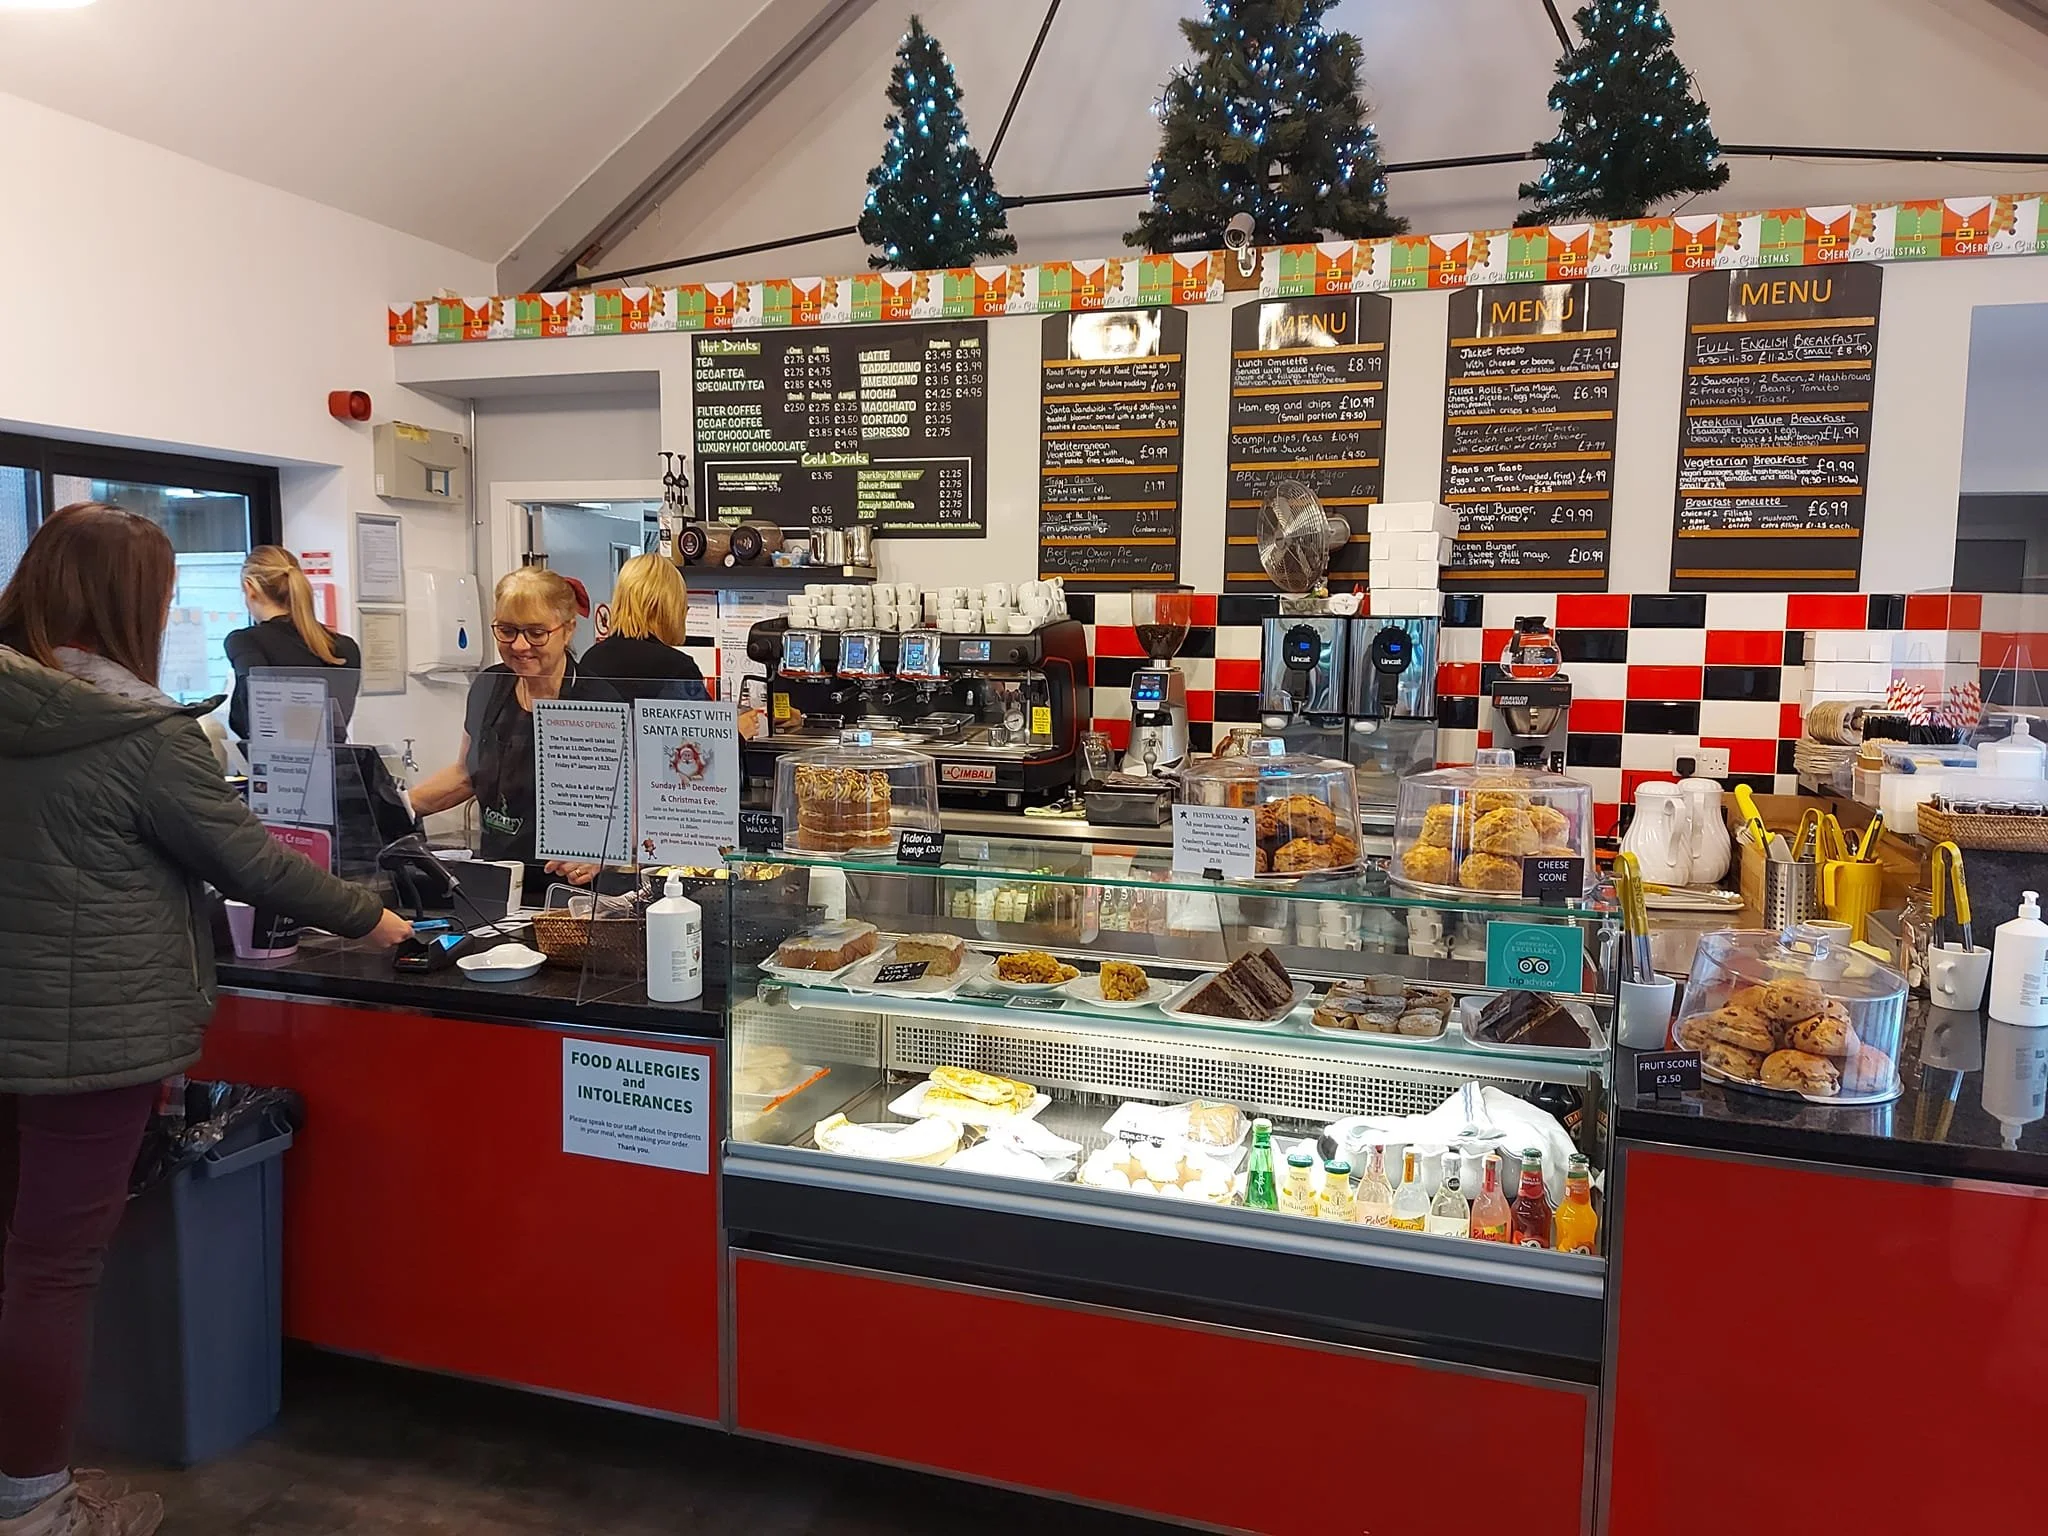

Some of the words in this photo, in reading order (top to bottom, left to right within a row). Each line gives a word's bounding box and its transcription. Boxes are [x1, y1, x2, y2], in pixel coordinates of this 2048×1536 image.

[1741, 279, 1832, 305] MENU
[1492, 298, 1573, 324] MENU
[1273, 312, 1346, 336] MENU
[700, 340, 720, 352] Hot
[722, 339, 758, 352] Drinks
[1697, 337, 1734, 354] FULL
[1740, 337, 1789, 351] ENGLISH
[1794, 333, 1866, 348] BREAKFAST
[860, 351, 890, 361] LATTE
[925, 350, 952, 360] £3.45
[1571, 347, 1612, 366] £7.99
[696, 358, 712, 367] TEA
[860, 362, 920, 374] CAPPUCCINO
[925, 363, 952, 372] £3.45
[1238, 359, 1262, 367] Lunch
[1348, 357, 1381, 372] £8.99
[696, 369, 726, 380] DECAF
[726, 368, 744, 378] TEA
[696, 380, 746, 392] SPECIALITY
[746, 380, 764, 390] TEA
[861, 376, 918, 387] AMERICANO
[1690, 377, 1698, 385] 2
[861, 389, 896, 400] MOCHA
[925, 388, 952, 398] £4.25
[1449, 387, 1473, 395] Filled
[1510, 384, 1530, 392] Tuna
[1573, 386, 1608, 400] £6.99
[1760, 385, 1795, 394] Beans,
[1801, 384, 1839, 392] Tomato
[698, 406, 726, 416] FILTER
[728, 405, 762, 415] COFFEE
[862, 401, 916, 412] MACCHIATO
[925, 402, 951, 411] £2.85
[1238, 403, 1262, 412] Ham,
[1265, 403, 1279, 414] egg
[1284, 401, 1301, 410] and
[1308, 400, 1331, 410] chips
[1339, 396, 1374, 410] £10.99
[698, 418, 726, 428] DECAF
[728, 417, 762, 427] COFFEE
[862, 414, 908, 424] CORTADO
[925, 414, 952, 424] £3.25
[1307, 412, 1337, 421] portion
[1689, 417, 1742, 429] Weekday
[1750, 416, 1783, 426] Value
[1790, 414, 1846, 425] Breakfast
[698, 430, 716, 440] HOT
[718, 428, 771, 440] CHOCOLATE
[862, 427, 910, 438] ESPRESSO
[925, 427, 950, 437] £2.75
[1822, 426, 1859, 443] £4.99
[698, 442, 732, 452] LUXURY
[732, 442, 750, 452] HOT
[752, 440, 806, 451] CHOCOLATE
[1048, 441, 1110, 450] Mediterranean
[1140, 445, 1167, 459] £9.99
[802, 453, 827, 465] Cold
[830, 453, 868, 464] Drinks
[1684, 457, 1748, 469] Vegetarian
[1753, 456, 1808, 466] Breakfast
[1817, 458, 1855, 474] £9.99
[1451, 465, 1479, 474] Beans
[1498, 463, 1522, 472] Toast
[1578, 469, 1606, 483] £4.99
[1451, 476, 1469, 486] Eggs
[1488, 473, 1514, 482] Toast
[1496, 483, 1520, 492] Toast
[1494, 503, 1536, 518] Burger,
[1551, 507, 1593, 523] £9.99
[1685, 498, 1731, 508] Breakfast
[1736, 498, 1781, 506] omelette
[1808, 500, 1848, 517] £6.99
[1486, 542, 1517, 550] Burger
[1568, 548, 1603, 564] £10.99
[642, 708, 701, 721] BREAKFAST
[704, 710, 731, 721] WITH
[547, 719, 584, 728] CHRISTMAS
[643, 725, 678, 736] SANTA
[682, 727, 732, 739] RETURNS!
[951, 766, 993, 779] CIMBALI
[651, 781, 676, 791] Sunday
[693, 784, 727, 793] December
[668, 795, 701, 805] Christmas
[703, 797, 718, 805] Eve.
[903, 833, 932, 844] Victoria
[902, 845, 924, 858] Sponge
[1538, 860, 1569, 870] CHEESE
[1538, 873, 1567, 882] SCONE
[1512, 946, 1557, 954] EXCELLENCE
[1509, 976, 1557, 987] tripadvisor
[572, 1051, 612, 1069] FOOD
[616, 1058, 700, 1081] ALLERGIES
[1639, 1062, 1665, 1071] FRUIT
[1667, 1059, 1697, 1068] SCONE
[623, 1077, 645, 1089] and
[1656, 1074, 1681, 1083] £2.50
[578, 1085, 693, 1114] INTOLERANCES
[569, 1114, 587, 1124] Please
[589, 1118, 605, 1127] speak
[638, 1126, 655, 1134] about
[657, 1128, 666, 1136] the
[668, 1130, 701, 1141] ingredients
[635, 1134, 656, 1144] making
[657, 1137, 670, 1145] your
[617, 1143, 636, 1151] Thank
[637, 1146, 649, 1154] you.
